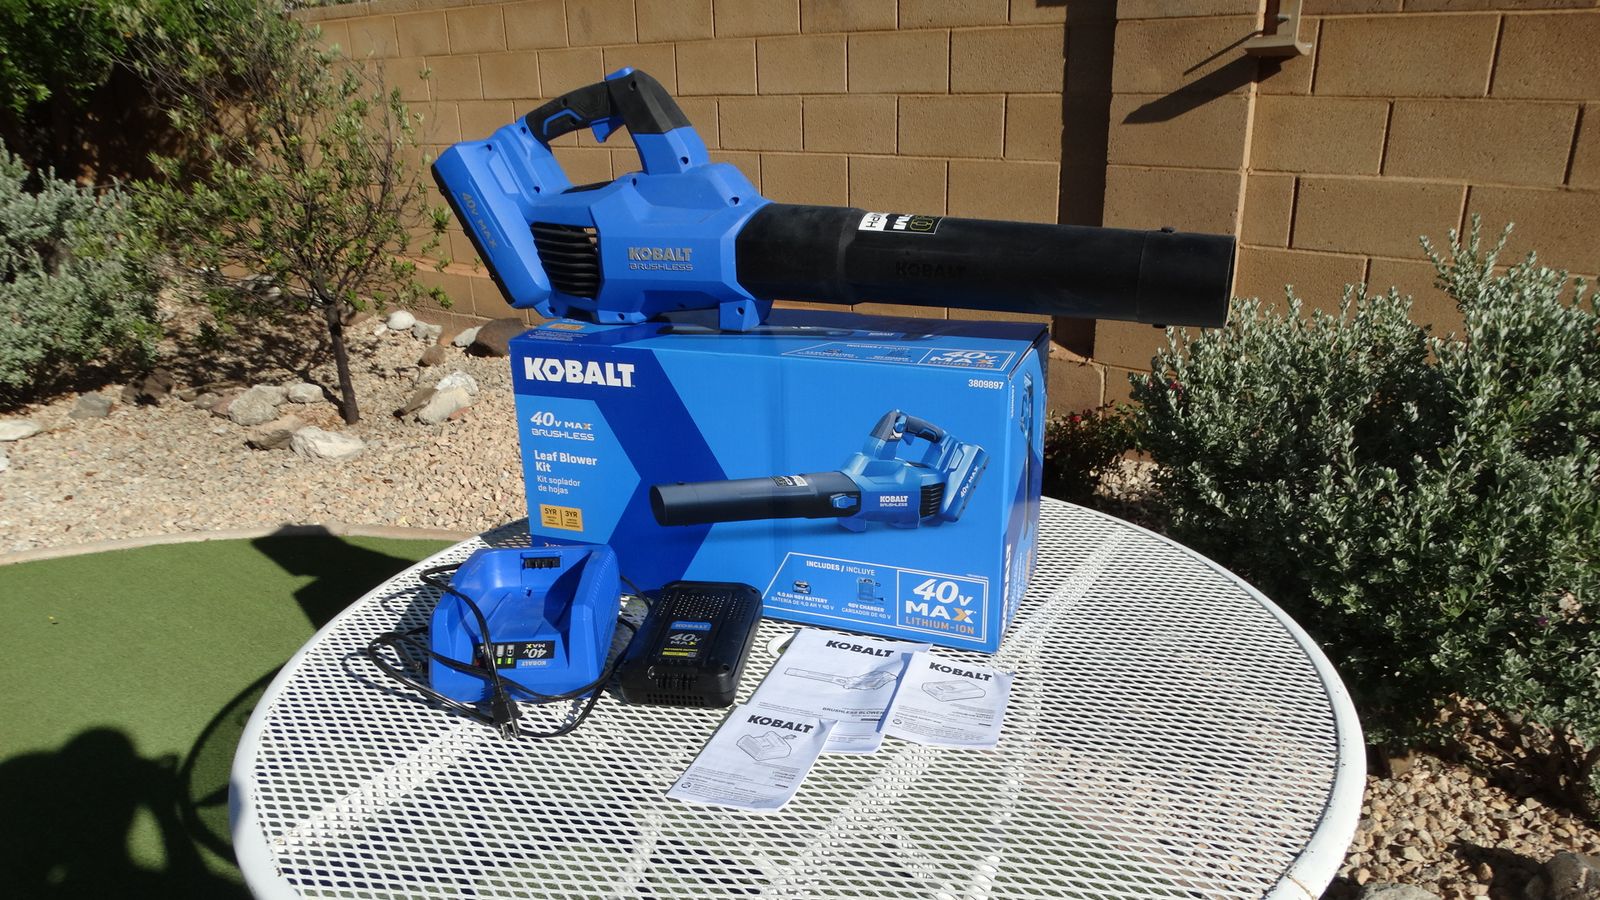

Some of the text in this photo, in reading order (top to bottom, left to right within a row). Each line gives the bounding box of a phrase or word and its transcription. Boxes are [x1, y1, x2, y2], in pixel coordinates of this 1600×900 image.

[628, 247, 692, 261] KOBALT
[629, 262, 694, 271] BRUSHLESS
[929, 355, 998, 365] MAX
[523, 356, 635, 388] KOBALT
[968, 378, 1004, 390] 3809897
[564, 421, 593, 430] MAX
[531, 428, 595, 441] BRUSHLESS
[534, 449, 598, 466] Leaf Blower
[535, 461, 551, 472] Kit
[537, 475, 581, 487] Kit soplador
[537, 484, 569, 495] de hojas
[879, 495, 909, 503] KOBALT
[544, 507, 578, 518] 5YR 3YR
[806, 560, 840, 571] INCLUDES
[846, 566, 876, 576] INCLUYE
[905, 599, 975, 625] MAX
[905, 615, 975, 635] LITHIUM-ION
[825, 639, 895, 658] KOBALT
[928, 661, 993, 682] KOBALT
[746, 714, 814, 734] KOBALT
